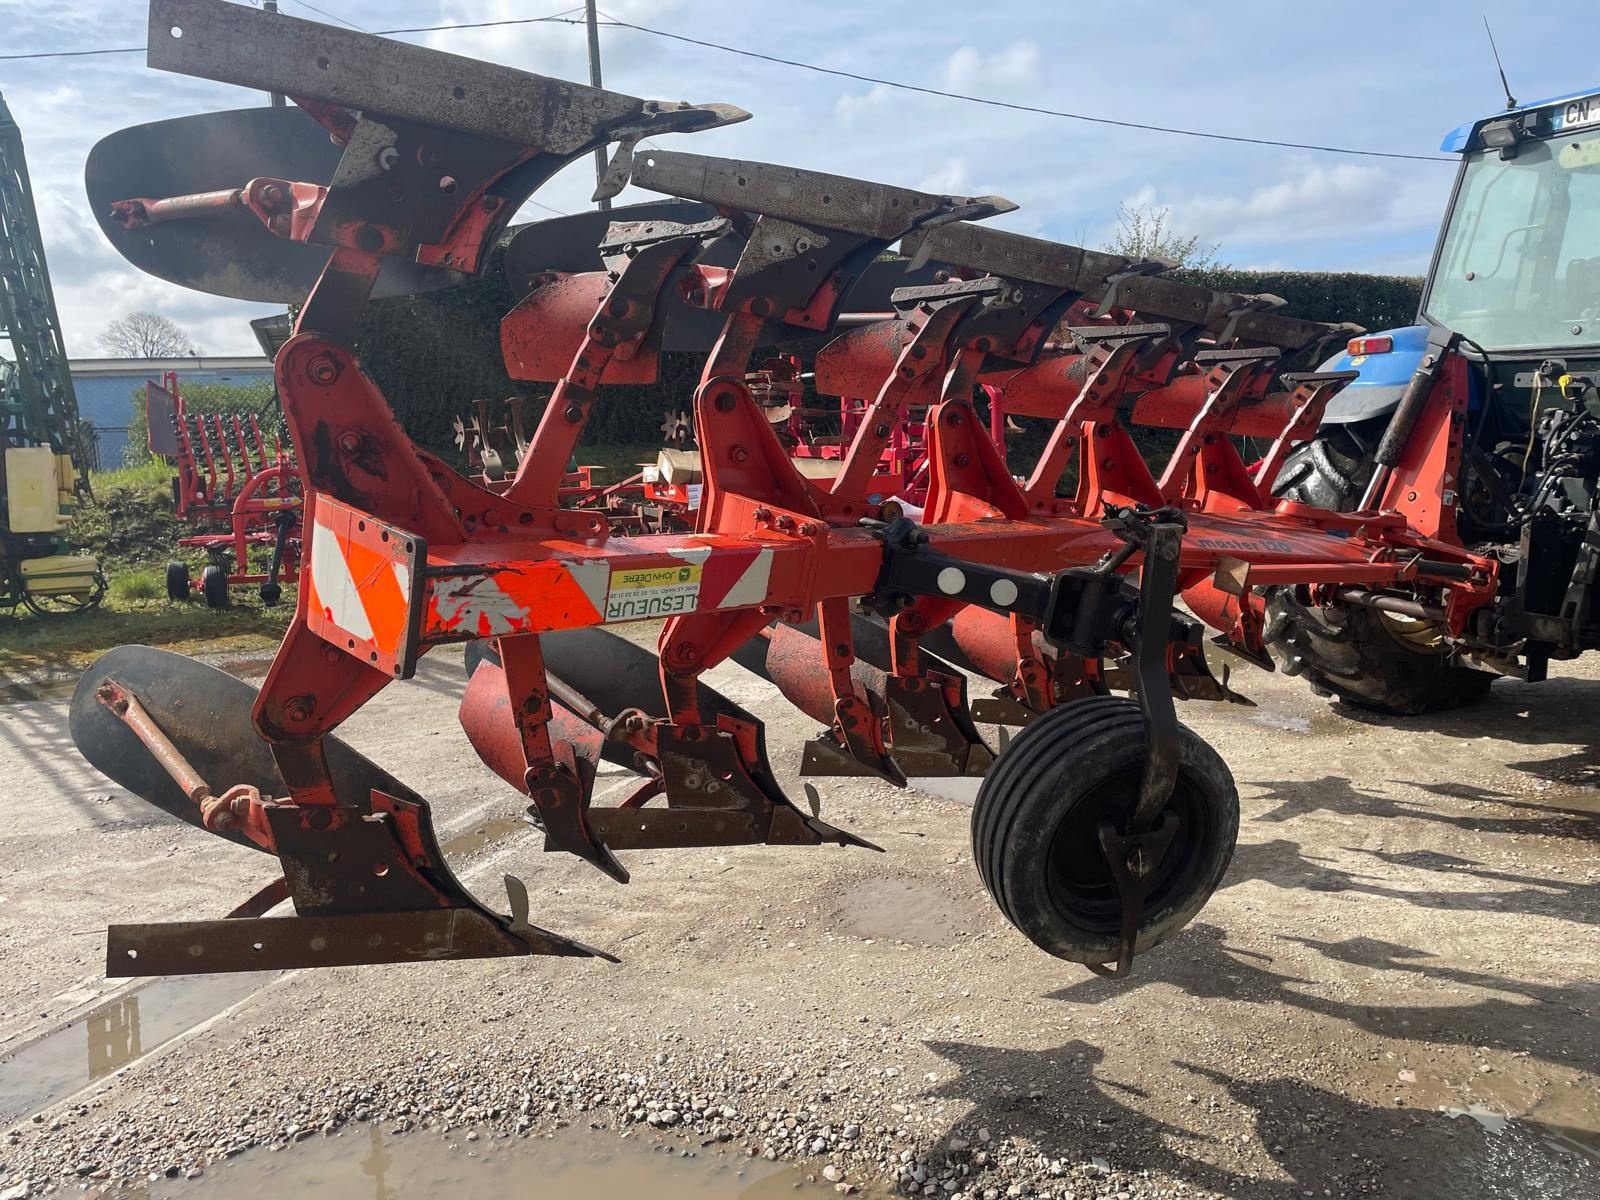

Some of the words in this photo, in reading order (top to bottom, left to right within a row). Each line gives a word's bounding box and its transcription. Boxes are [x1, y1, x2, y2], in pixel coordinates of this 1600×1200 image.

[623, 573, 652, 583] DEERE
[653, 571, 676, 580] JOHN
[608, 594, 695, 617] LESUEUR
